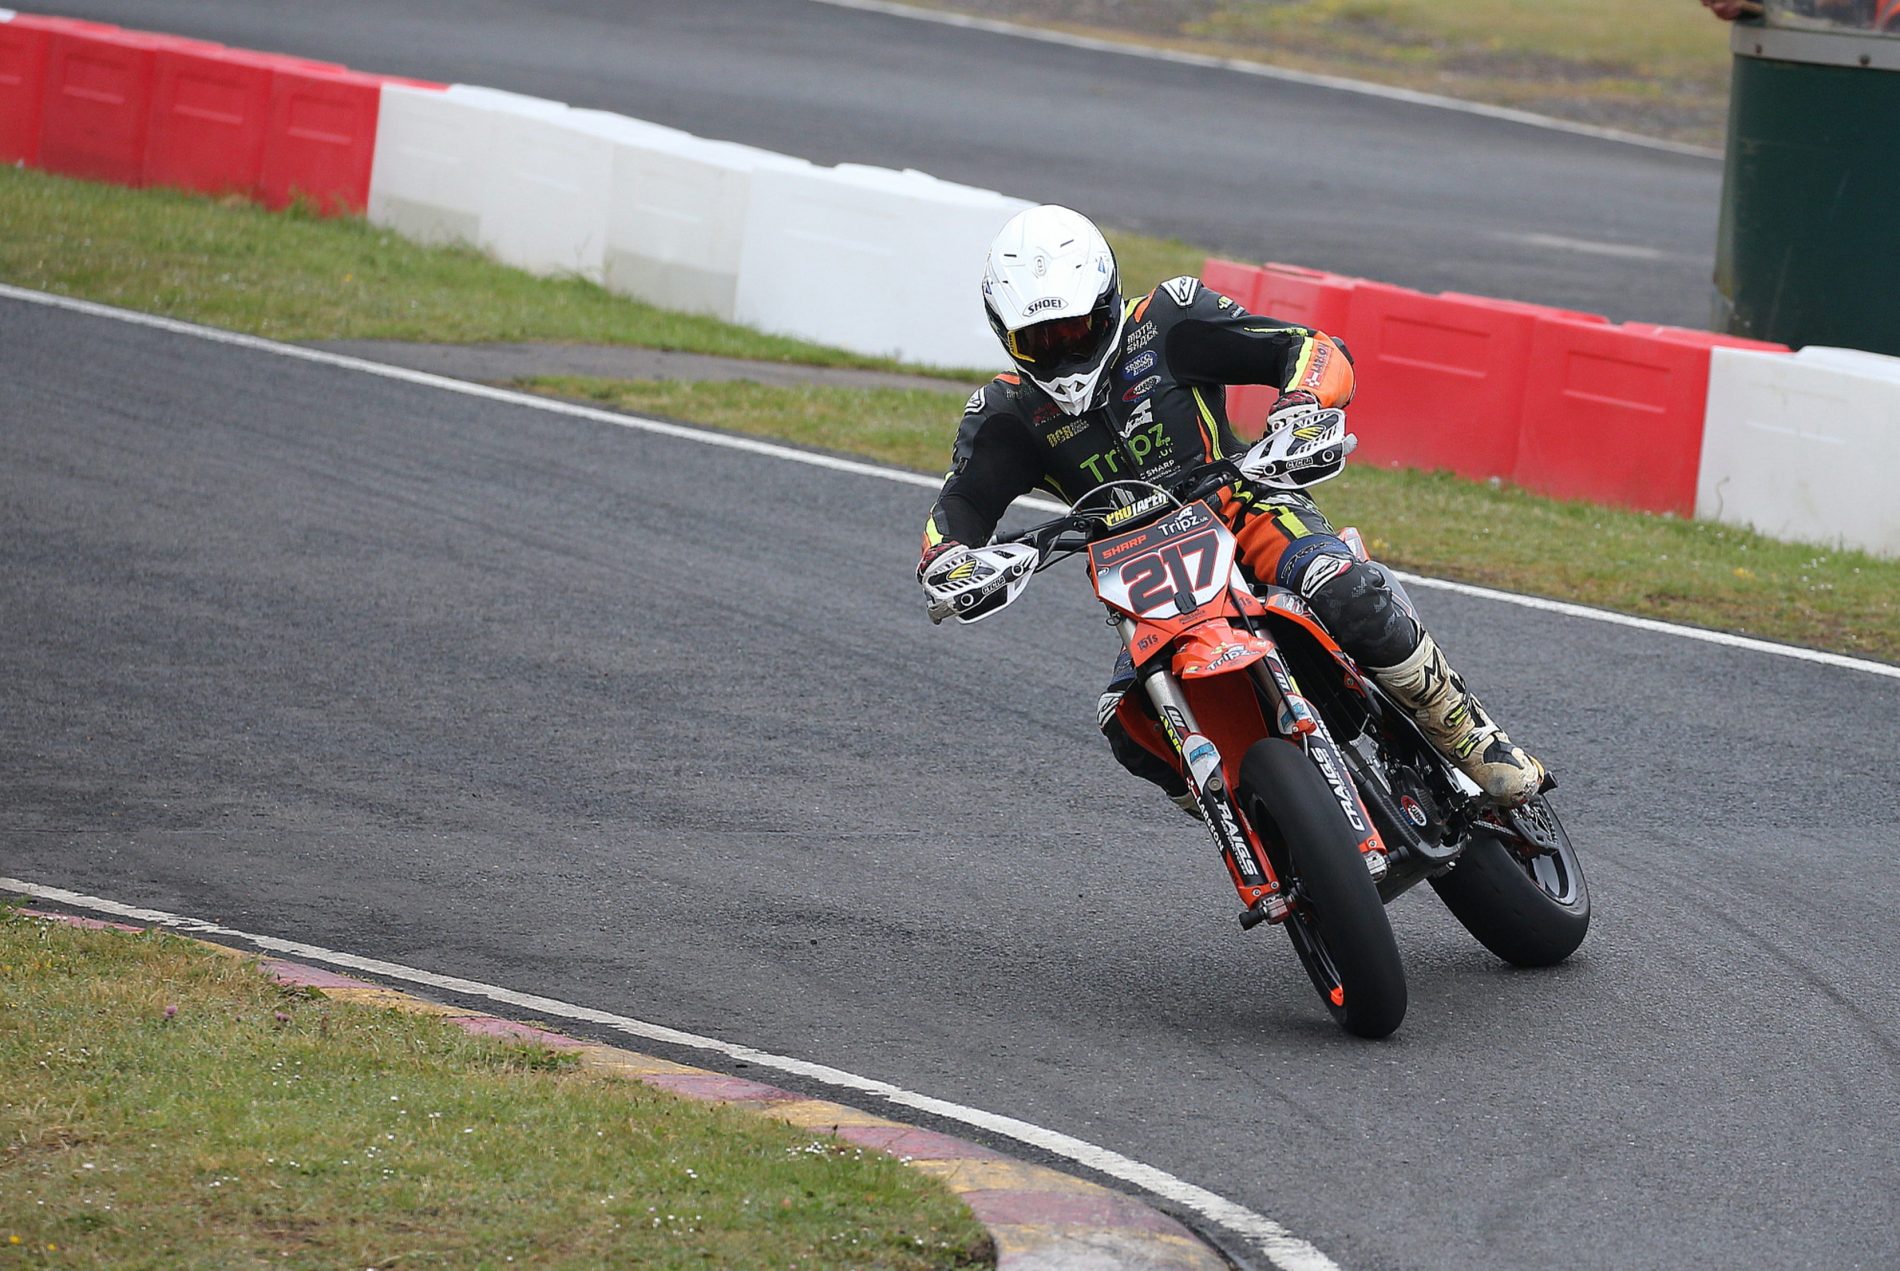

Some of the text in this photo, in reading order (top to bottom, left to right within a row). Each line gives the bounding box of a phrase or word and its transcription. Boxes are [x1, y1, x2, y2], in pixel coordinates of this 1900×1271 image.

[1028, 299, 1062, 315] SHOEI
[1126, 325, 1159, 354] SHACK
[1127, 320, 1153, 344] MOTO
[1145, 459, 1175, 477] SHARP
[1102, 534, 1148, 560] SHARP
[1119, 529, 1220, 616] 217
[1310, 746, 1366, 831] CRAIGS
[1196, 797, 1225, 851] LARSSON
[1213, 798, 1259, 876] RAIGS
